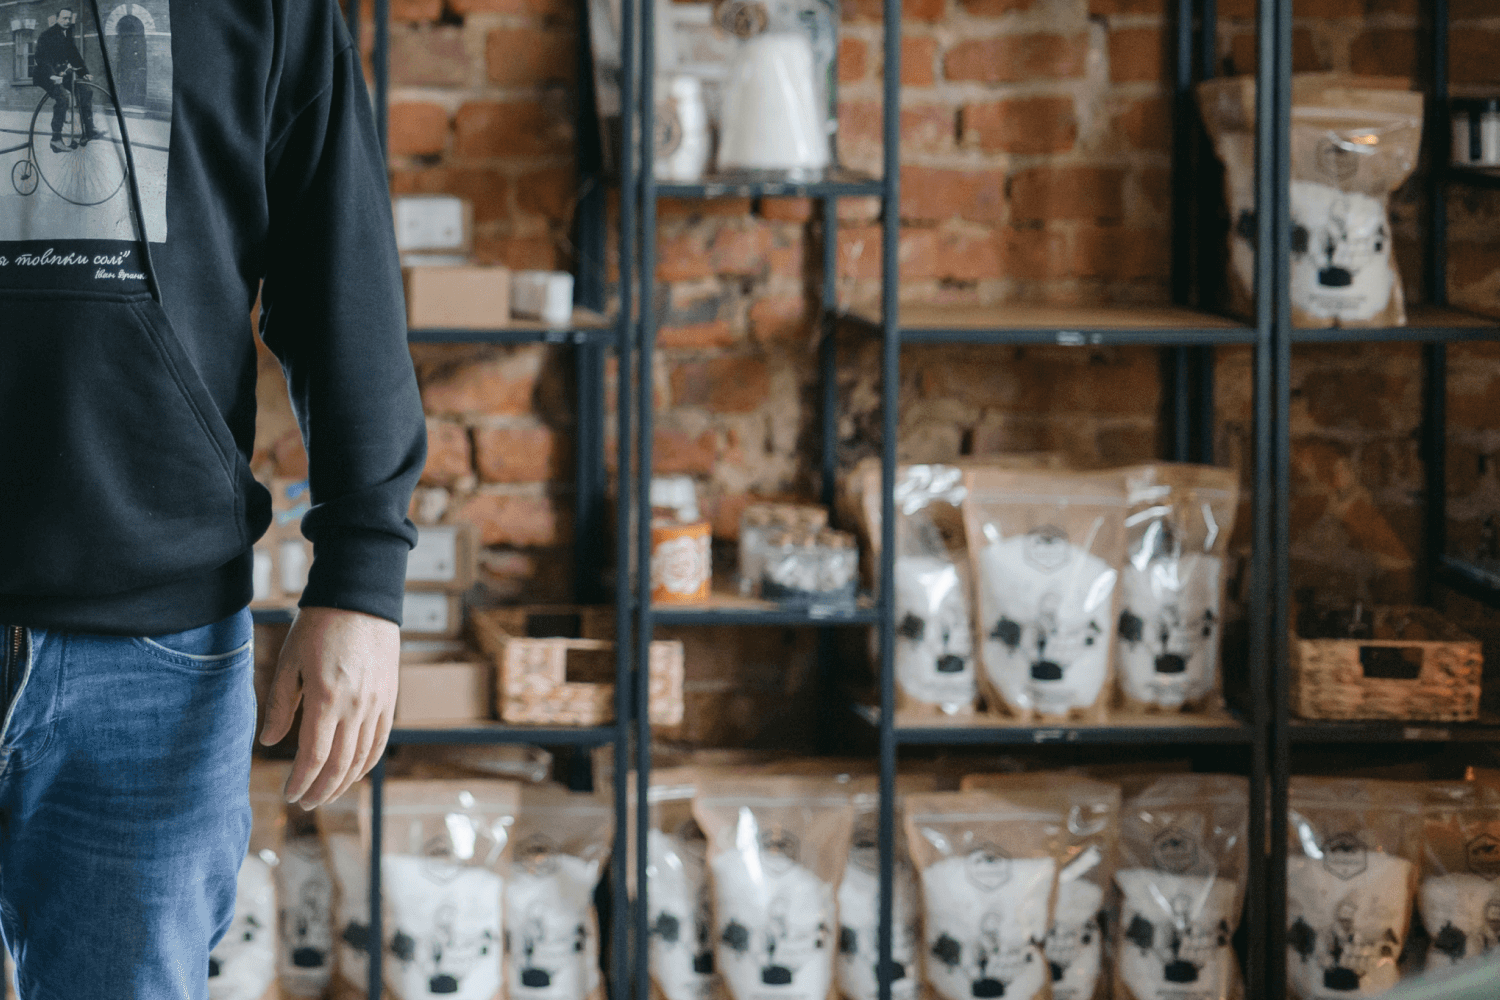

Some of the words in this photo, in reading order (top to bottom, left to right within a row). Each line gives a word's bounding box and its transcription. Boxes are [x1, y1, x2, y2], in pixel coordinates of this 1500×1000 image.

[14, 247, 89, 266] товпки
[94, 267, 117, 280] Іван
[117, 268, 147, 281] Франк
